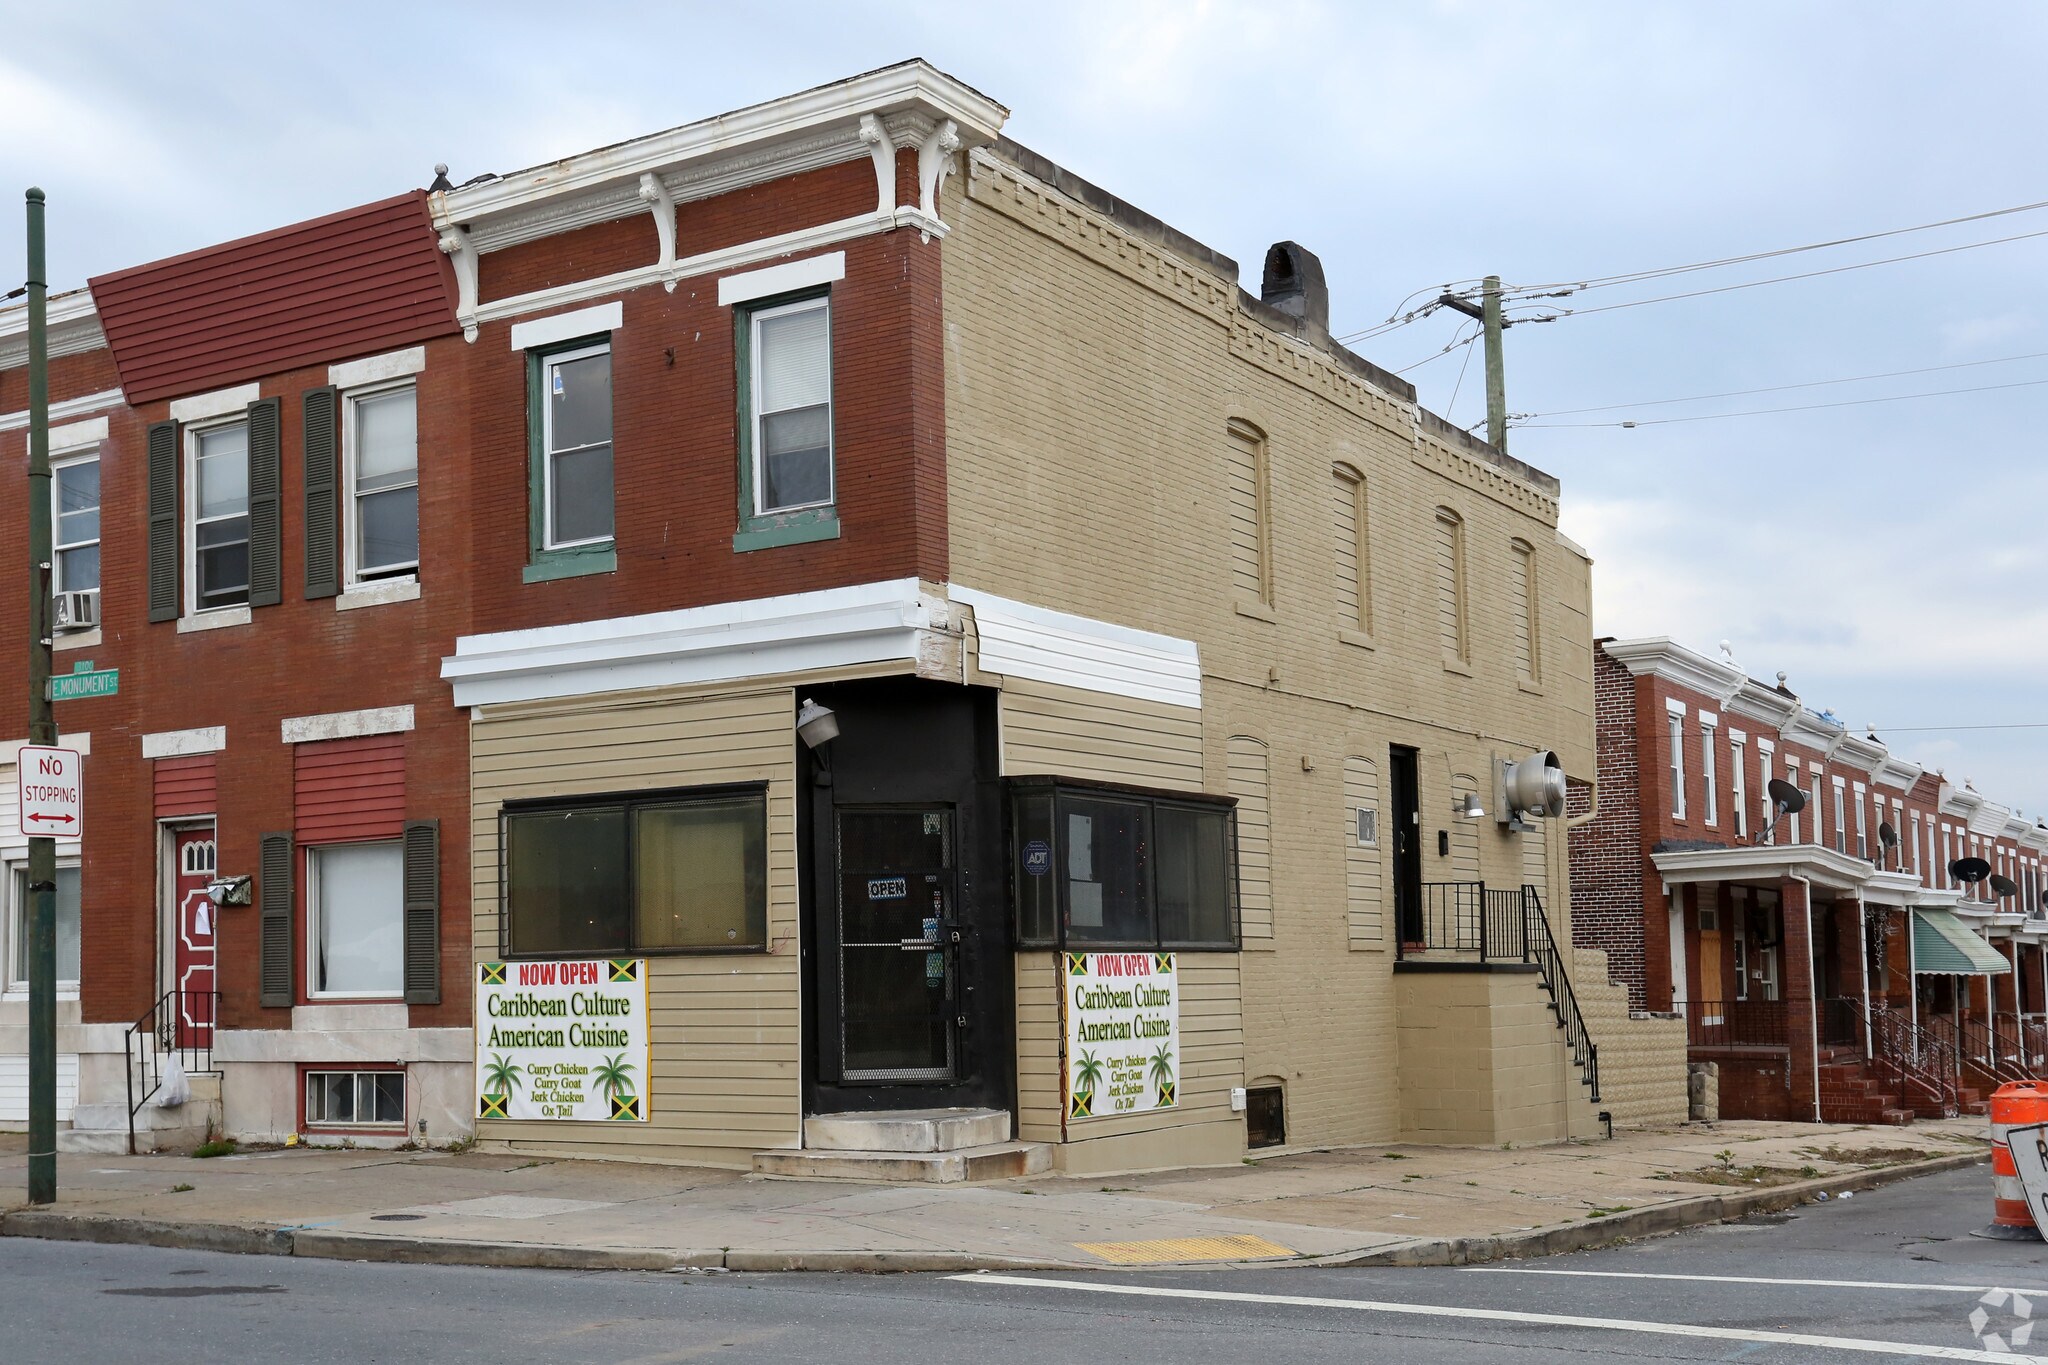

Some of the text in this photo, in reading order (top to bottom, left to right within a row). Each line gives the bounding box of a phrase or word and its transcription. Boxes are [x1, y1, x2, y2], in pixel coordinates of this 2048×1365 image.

[60, 674, 110, 696] MONUMENT
[39, 758, 63, 776] NO
[25, 785, 77, 804] STOPPING
[1027, 852, 1047, 864] ADT
[870, 881, 905, 896] OPEN
[1097, 954, 1151, 977] NOW OPEN
[519, 962, 598, 986] NOW OPEN
[487, 991, 630, 1018] Caribbean Culture
[1075, 983, 1171, 1011] Caribbean Culture
[487, 1022, 629, 1048] American Cuisine
[1077, 1012, 1171, 1043] American Cuisine
[527, 1063, 588, 1077] Curry Chicken
[1106, 1055, 1147, 1070] Curry Chicken
[534, 1077, 581, 1091] Curry Goat
[1111, 1069, 1143, 1084] Curry Goat
[530, 1091, 584, 1103] Jerk Chicken
[1107, 1083, 1144, 1098] Jerk Chicken
[541, 1104, 573, 1117] Ox Tail
[1124, 1097, 1136, 1109] Tail
